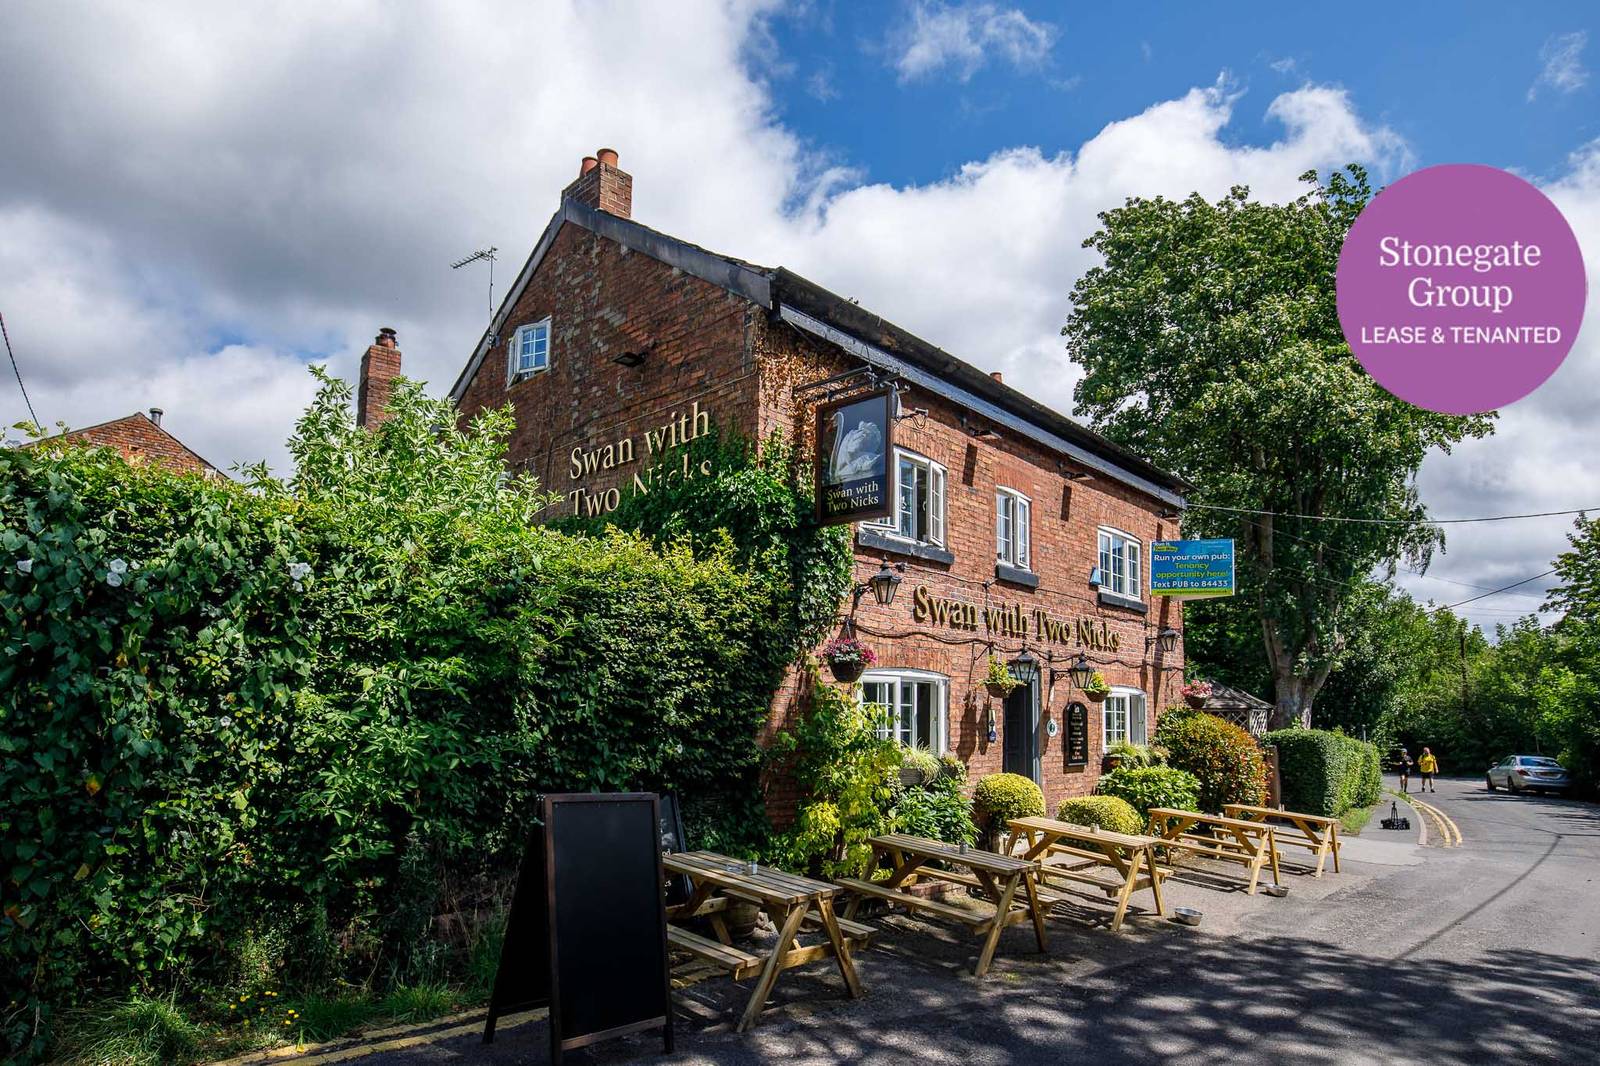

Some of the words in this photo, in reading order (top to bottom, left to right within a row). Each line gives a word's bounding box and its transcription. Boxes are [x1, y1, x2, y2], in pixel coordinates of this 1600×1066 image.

[569, 438, 634, 480] Swan
[643, 400, 711, 454] with
[827, 488, 852, 500] Swan
[856, 481, 879, 494] with
[569, 487, 621, 518] Two
[827, 500, 848, 513] Two
[850, 493, 879, 509] Nicks
[1171, 555, 1190, 563] your
[1156, 570, 1205, 579] opportunity
[1172, 580, 1189, 588] PUB
[1201, 580, 1228, 588] 84433
[913, 583, 979, 631] Swan
[983, 601, 1031, 639] with
[1032, 607, 1073, 645] Two
[1076, 616, 1121, 652] Nicks
